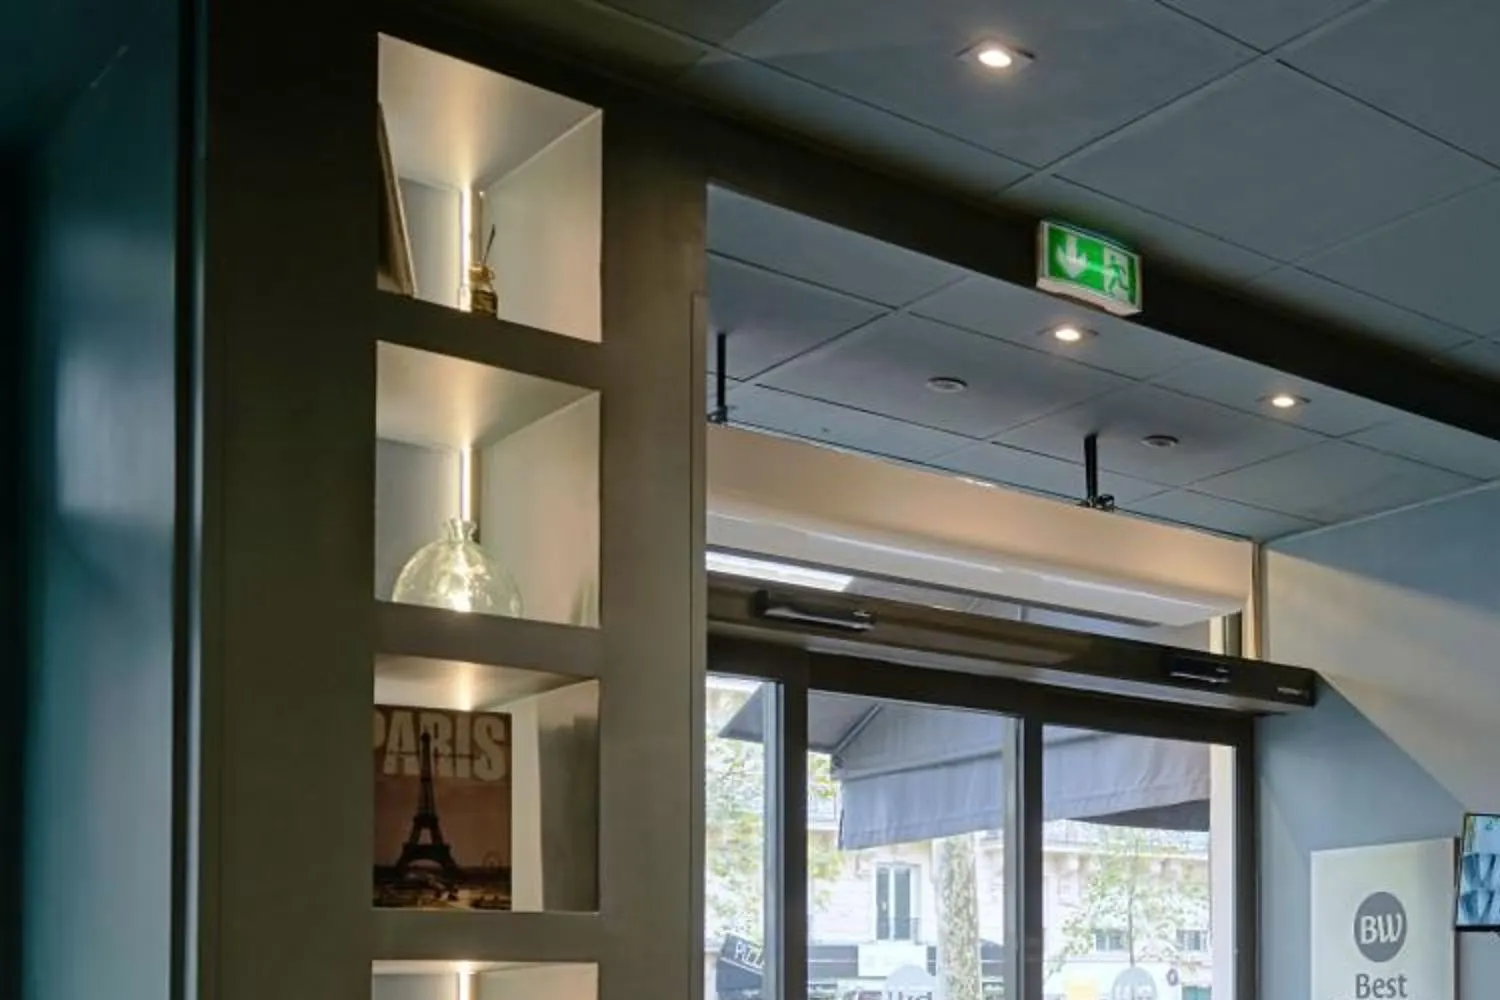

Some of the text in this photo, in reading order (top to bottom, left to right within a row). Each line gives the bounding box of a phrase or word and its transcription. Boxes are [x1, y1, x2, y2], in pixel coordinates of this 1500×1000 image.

[1361, 913, 1402, 945] BW
[734, 940, 765, 968] PIZZ
[1355, 973, 1408, 999] Best
